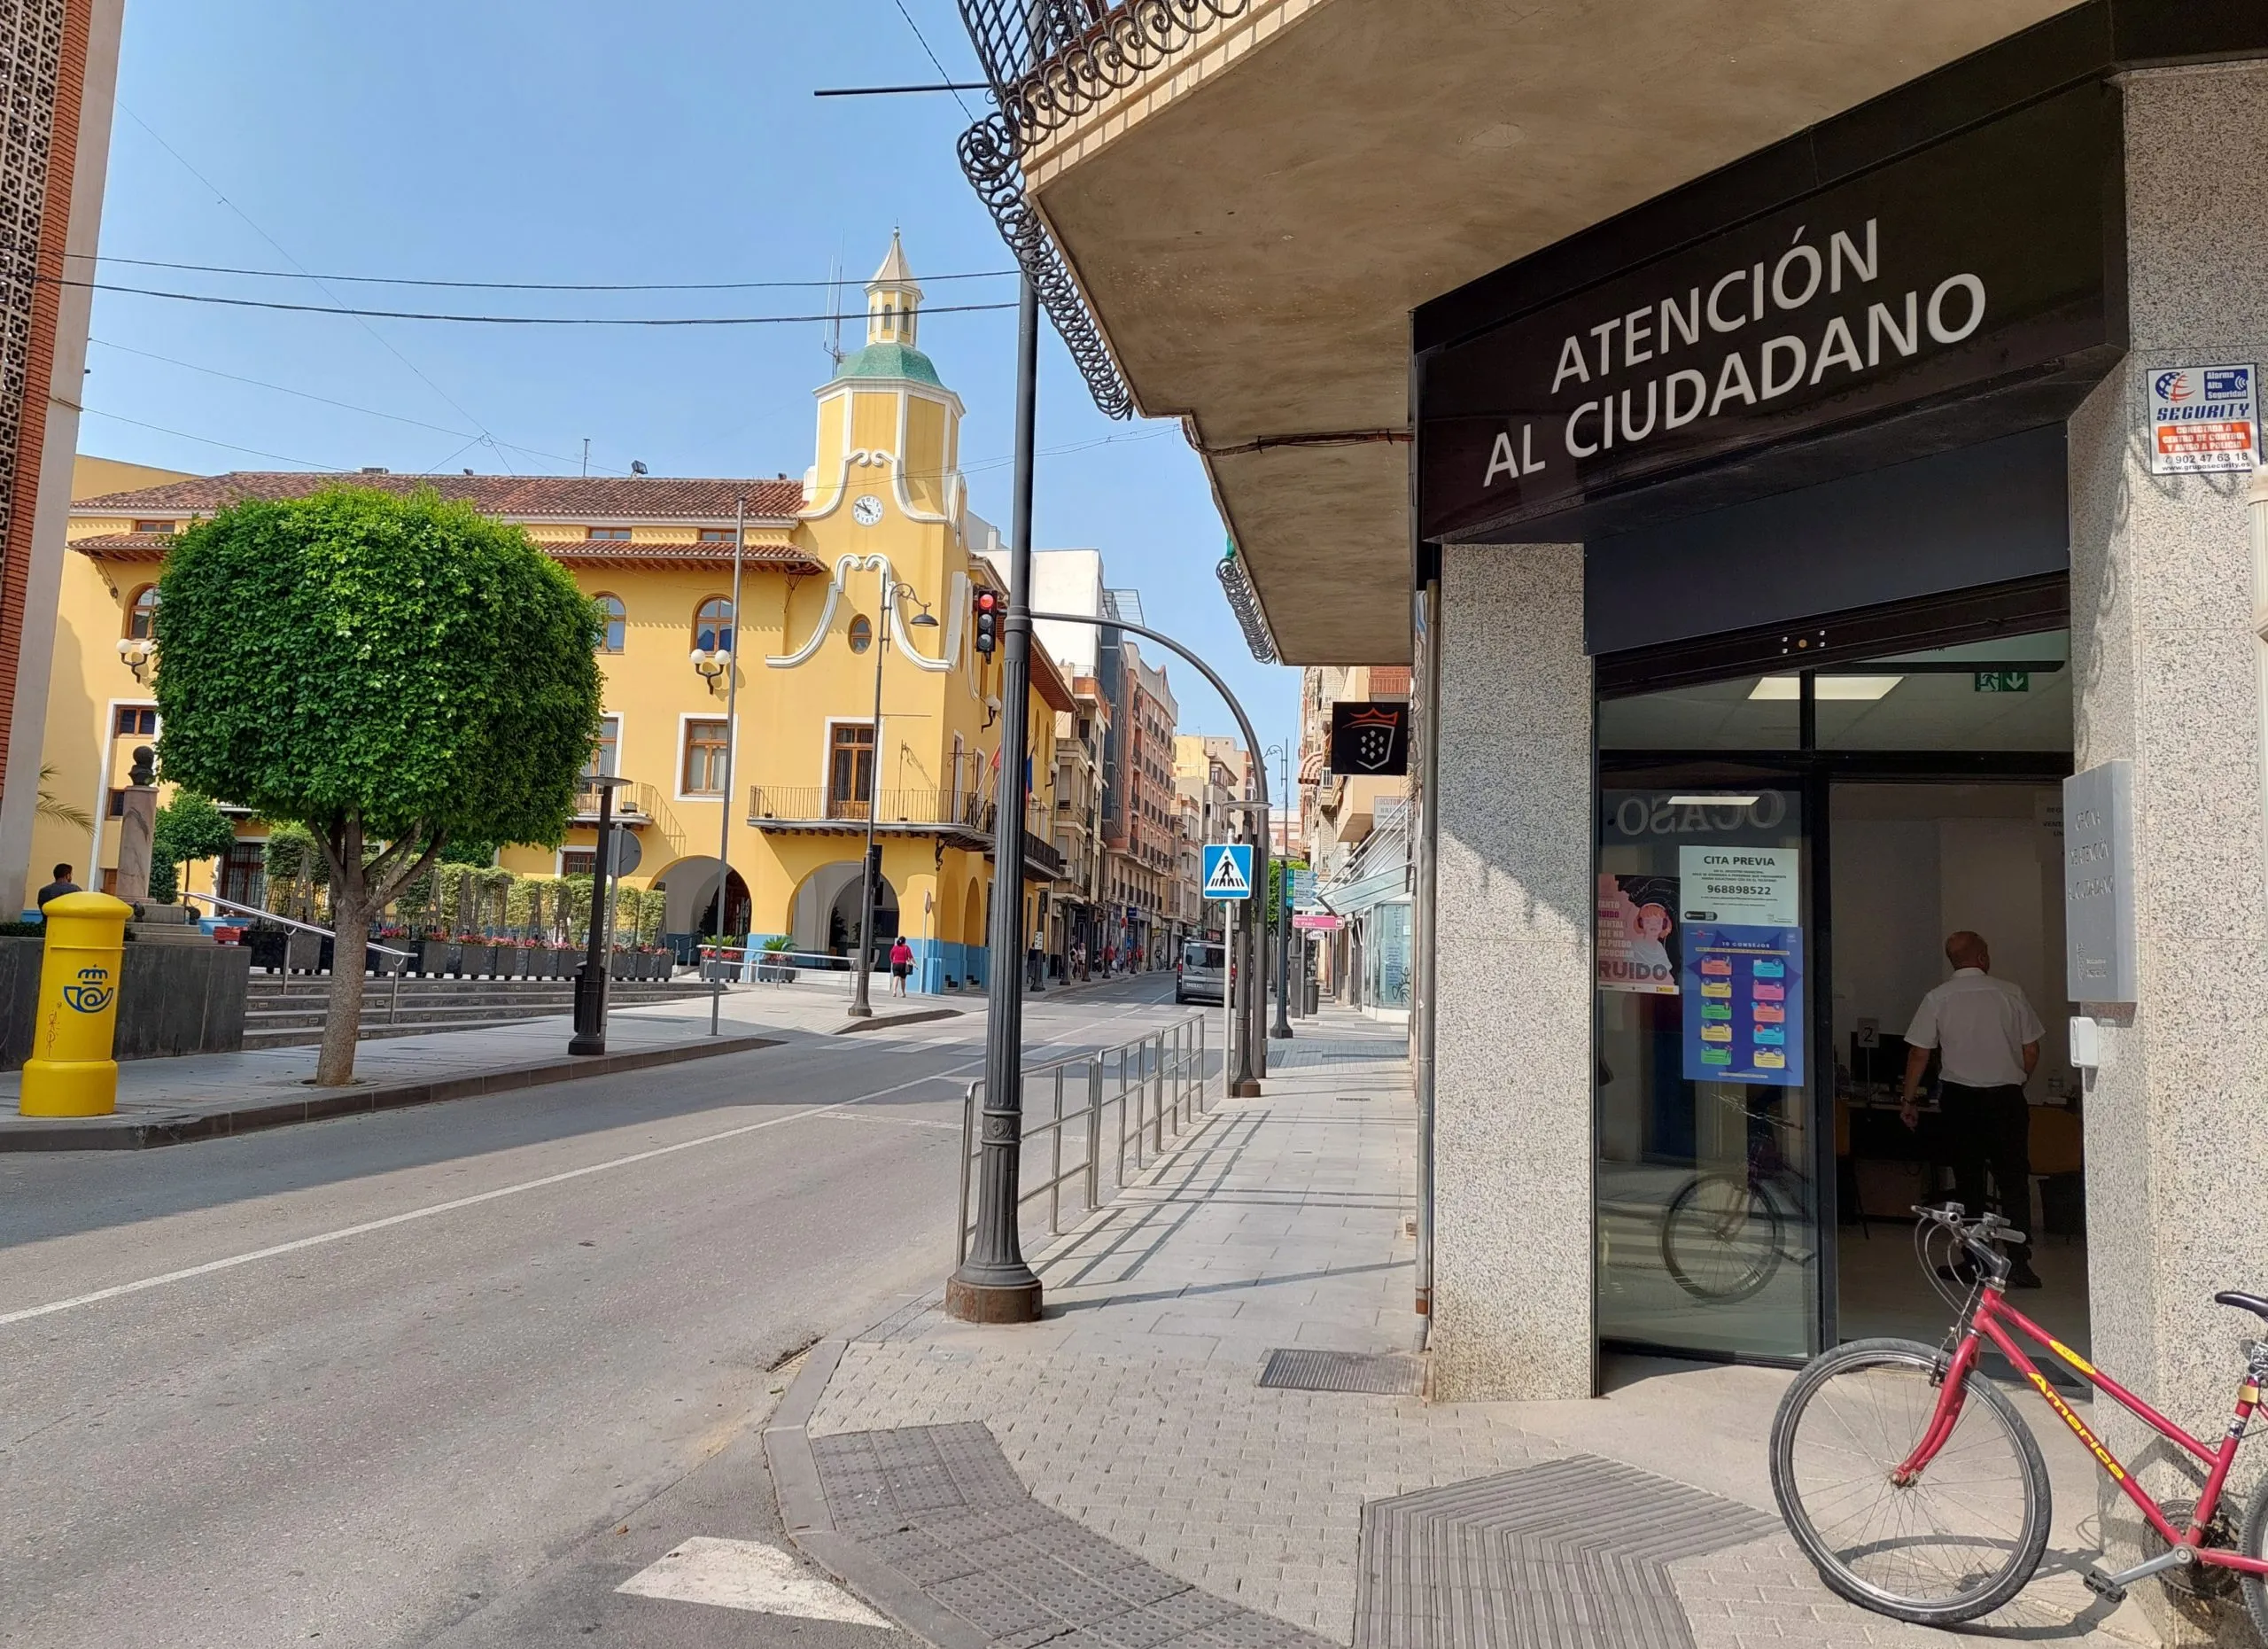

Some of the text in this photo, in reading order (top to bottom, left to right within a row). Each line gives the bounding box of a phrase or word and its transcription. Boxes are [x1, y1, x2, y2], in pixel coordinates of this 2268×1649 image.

[1550, 217, 1878, 393] ATENCIÓN
[1483, 272, 1986, 486] AL CIUDADANO
[2207, 371, 2234, 380] Alarma
[2207, 390, 2247, 400] Seguridad
[2156, 403, 2250, 422] SECURITY
[2176, 424, 2224, 434] CONECTADA
[2162, 432, 2247, 444] CENTRO DE CONTROL
[2176, 452, 2249, 464] 902 47 63 18
[2162, 462, 2250, 471] www.gruposecurity.es
[1704, 855, 1775, 867] CITA PREVIA
[1707, 884, 1772, 896] 968898522
[1598, 960, 1668, 981] RUIDO
[1863, 1026, 1874, 1043] 2
[2028, 1373, 2124, 1480] America
